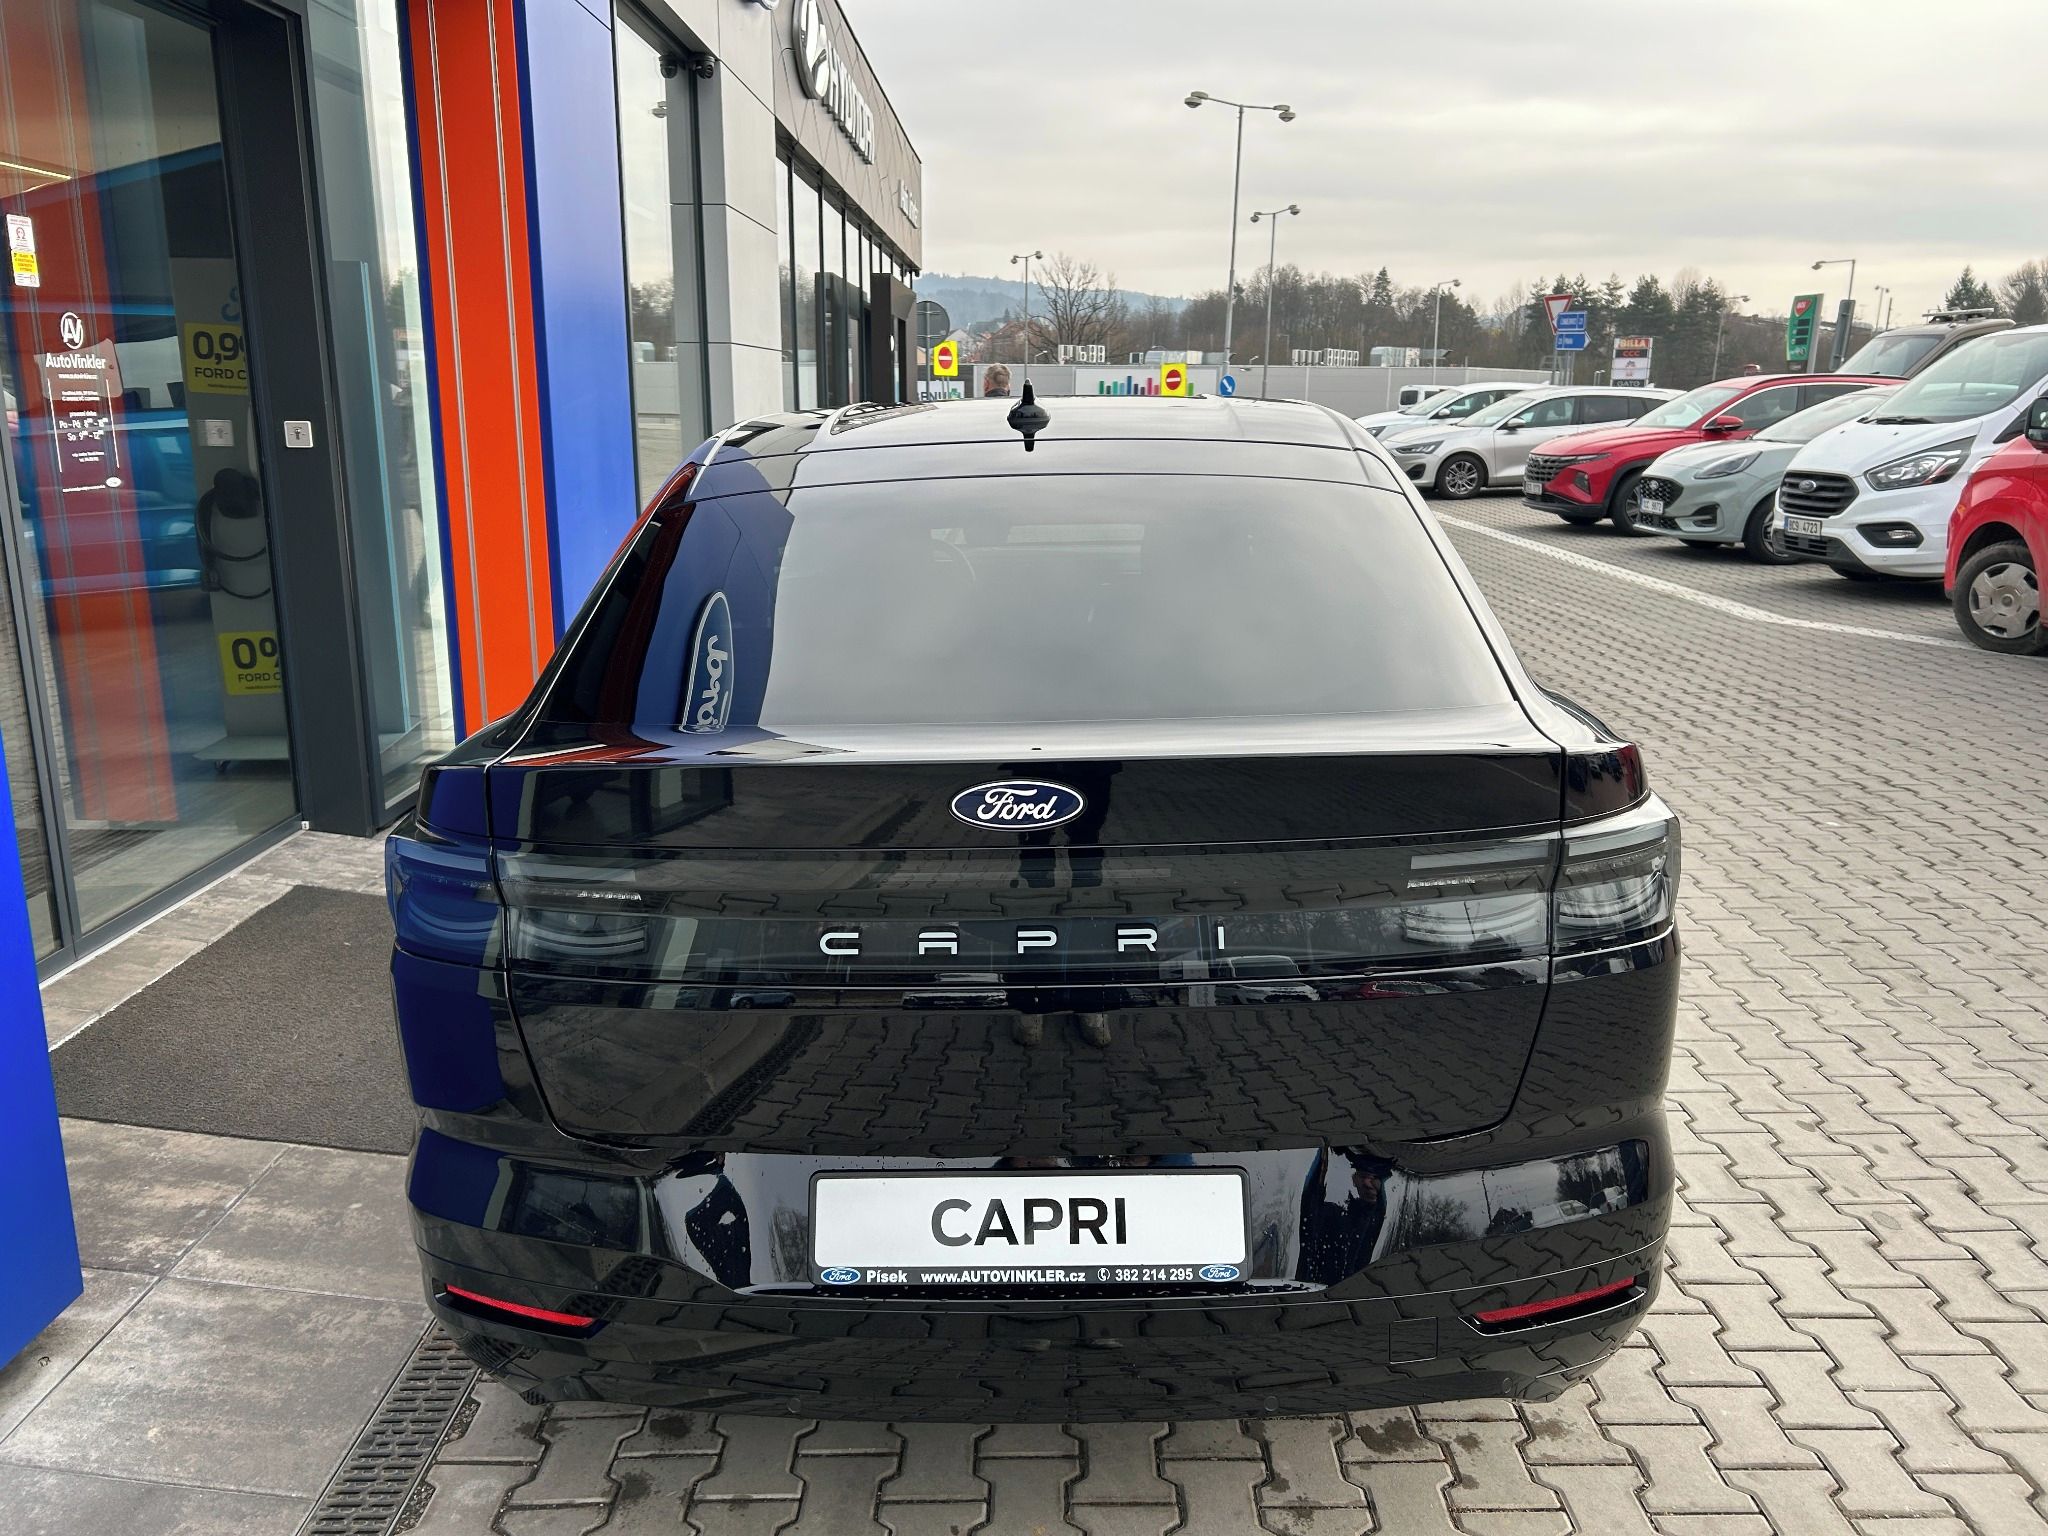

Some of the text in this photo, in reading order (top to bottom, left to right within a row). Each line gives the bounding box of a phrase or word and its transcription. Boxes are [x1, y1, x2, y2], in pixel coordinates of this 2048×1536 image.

[193, 331, 245, 365] 0,9
[1620, 338, 1648, 349] BILLA
[46, 352, 106, 369] AutoVinkler
[194, 367, 235, 379] FORD
[1802, 520, 1818, 534] 4723
[238, 672, 271, 682] FORD
[976, 787, 1058, 820] Ford
[819, 926, 1226, 955] CAPRI
[931, 1197, 1127, 1247] CAPRI
[866, 1269, 908, 1283] Písek
[920, 1269, 1086, 1283] www.AUTOVINKLER.cz
[1115, 1269, 1139, 1281] 382
[1142, 1268, 1166, 1281] 214
[1169, 1267, 1194, 1281] 295
